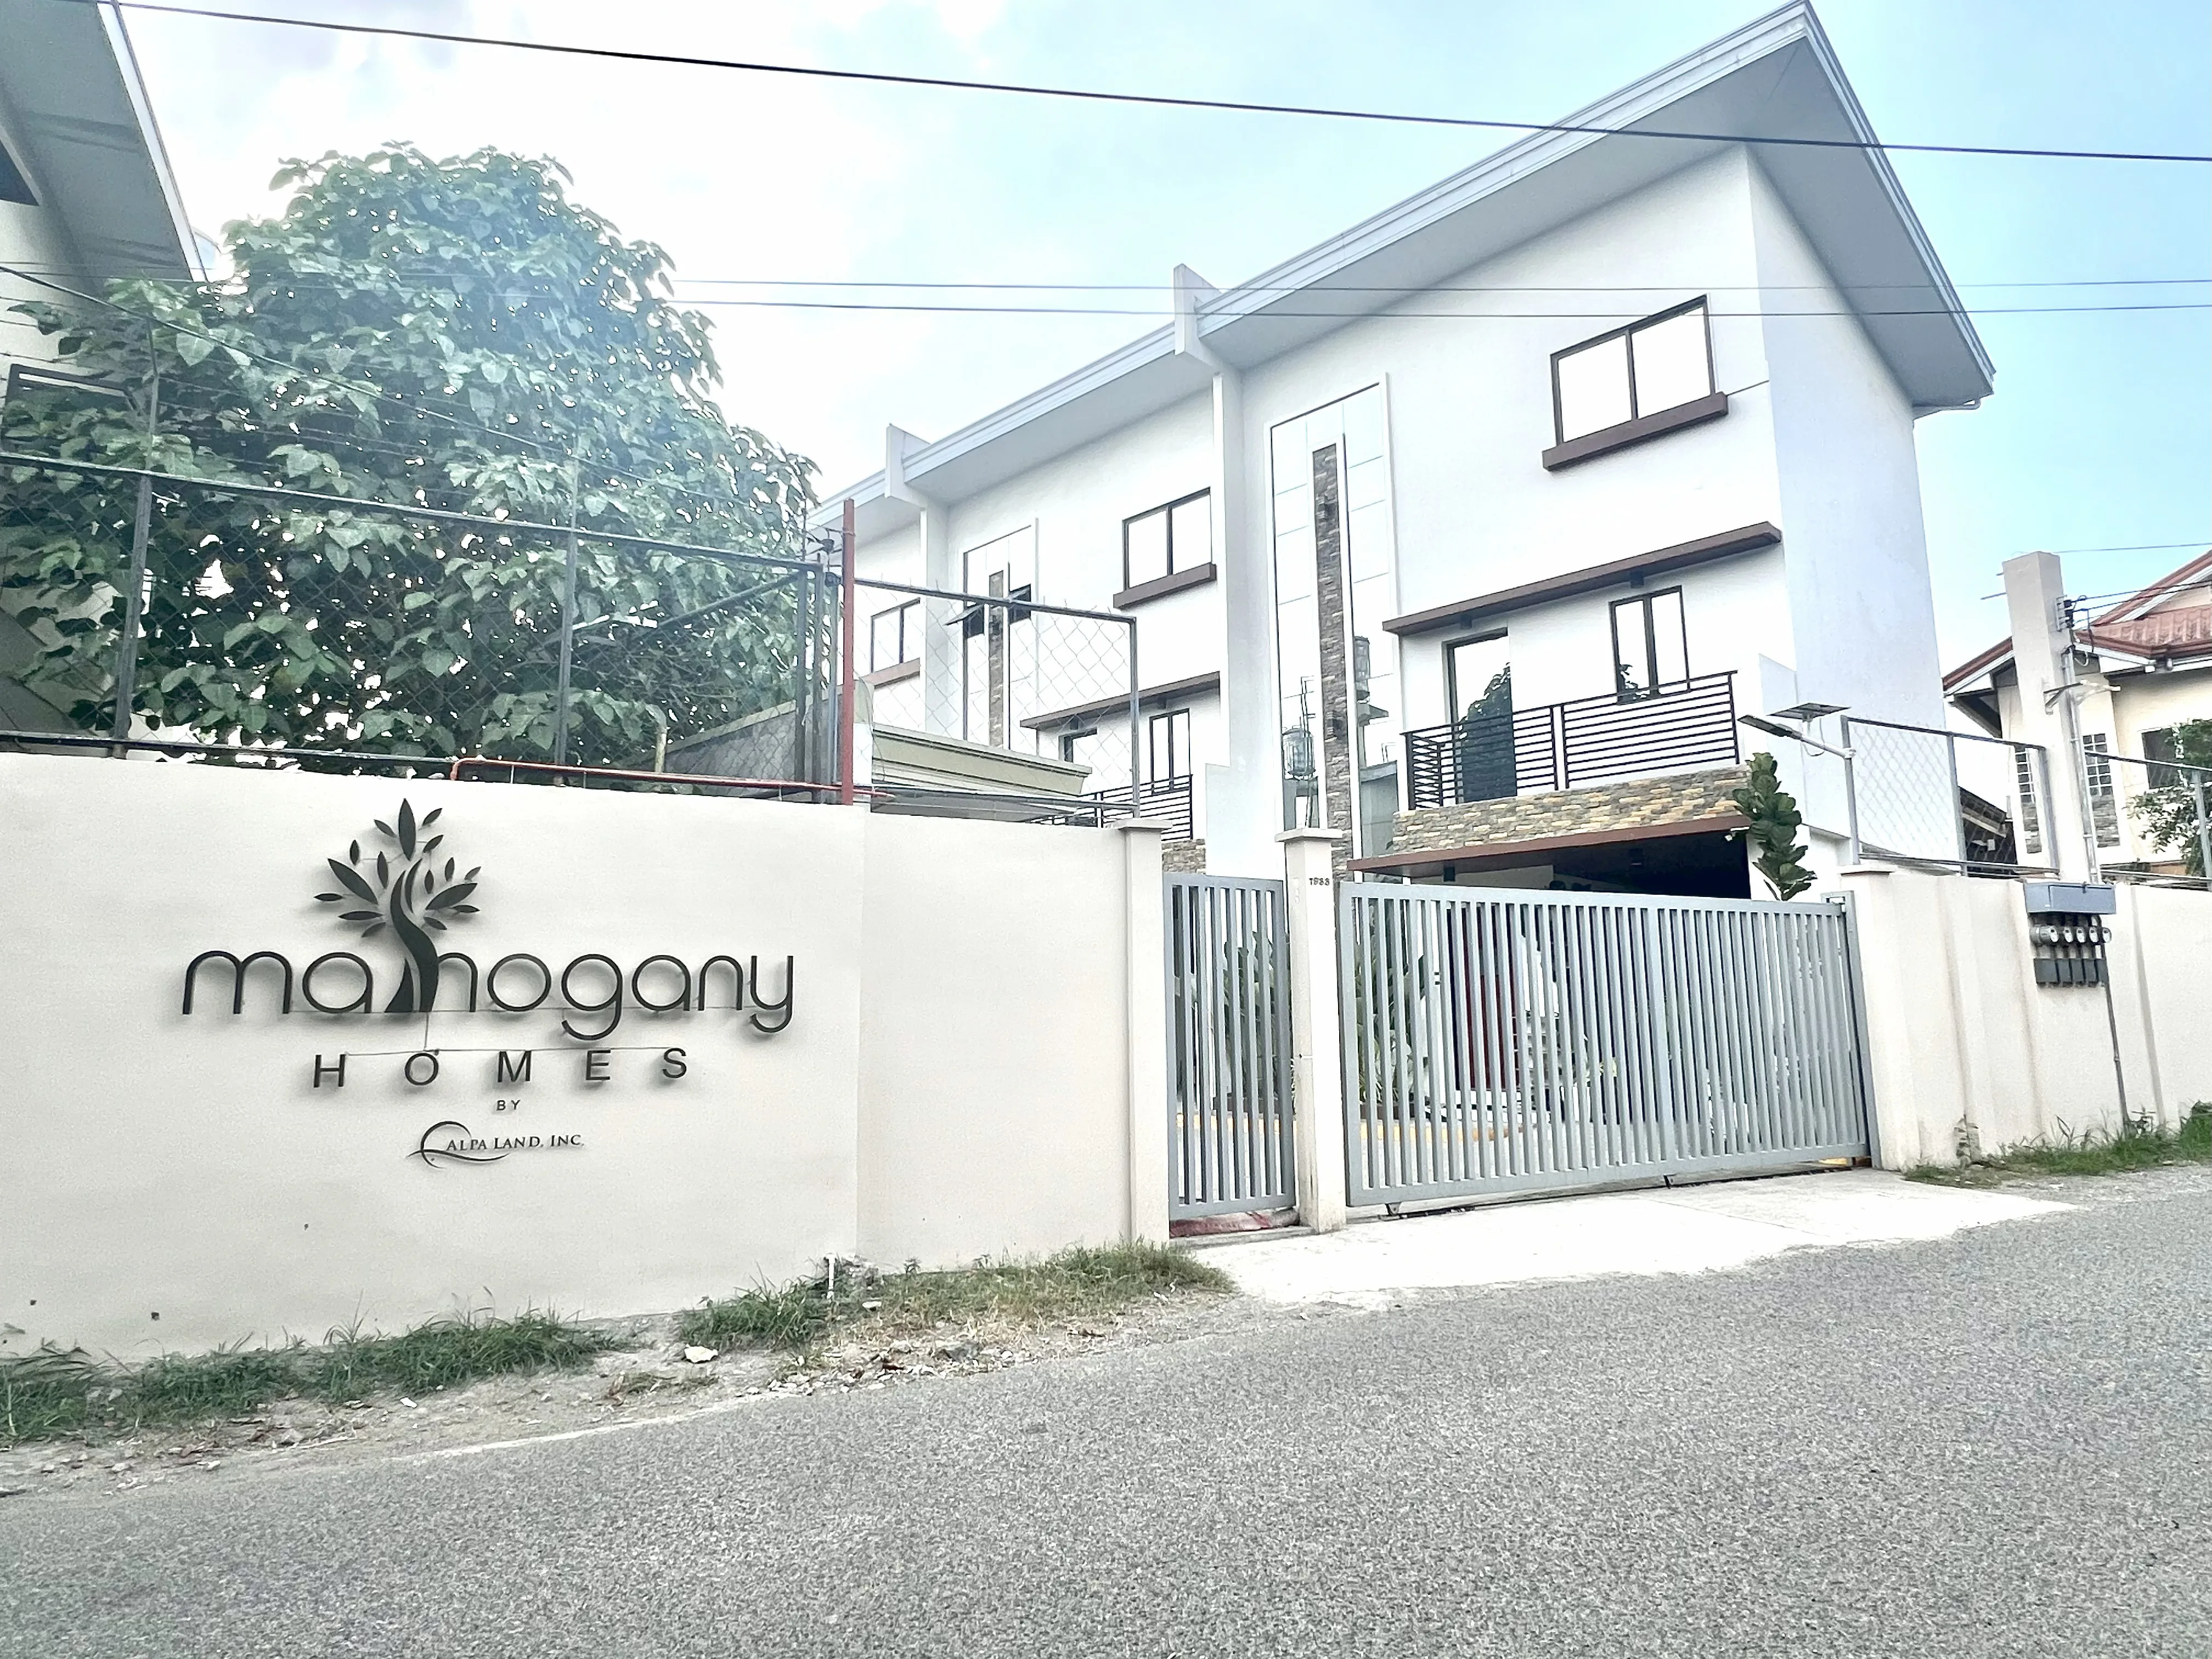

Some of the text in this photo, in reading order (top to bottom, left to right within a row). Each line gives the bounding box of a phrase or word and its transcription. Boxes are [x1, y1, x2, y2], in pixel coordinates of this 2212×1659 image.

[182, 933, 794, 1041] mahogany
[313, 1047, 687, 1088] HOMES
[496, 1099, 521, 1111] BY
